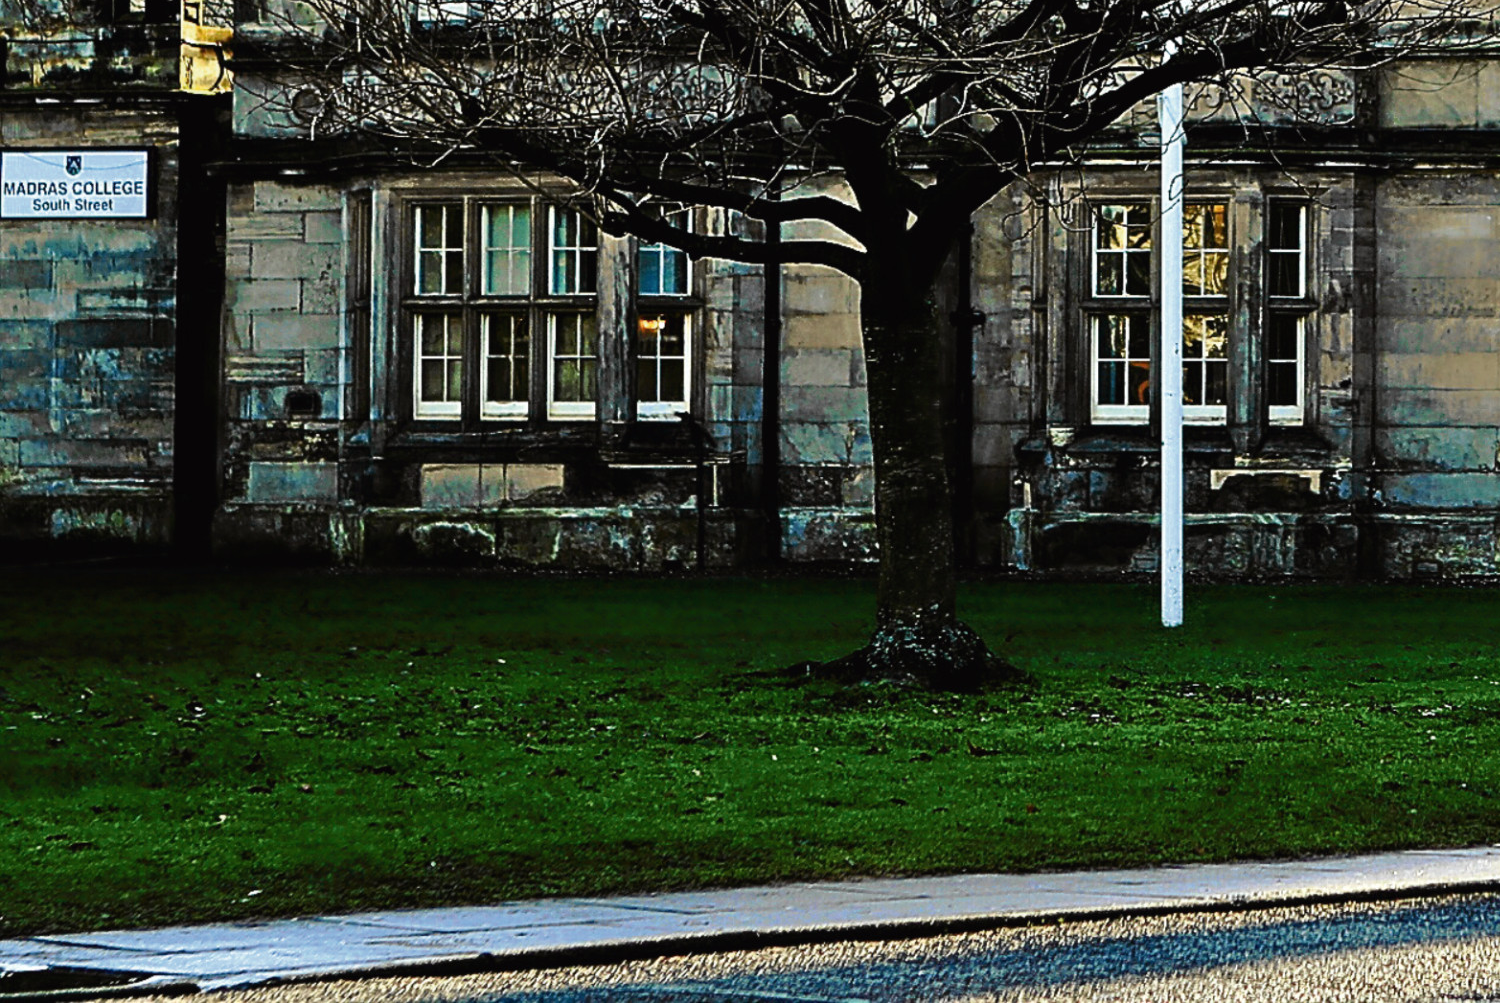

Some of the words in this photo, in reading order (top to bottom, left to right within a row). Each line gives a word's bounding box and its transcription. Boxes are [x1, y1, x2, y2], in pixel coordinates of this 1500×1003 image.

[4, 182, 68, 196] MADRAS
[72, 181, 144, 195] COLLEGE
[33, 198, 70, 211] South
[75, 198, 113, 211] Street
